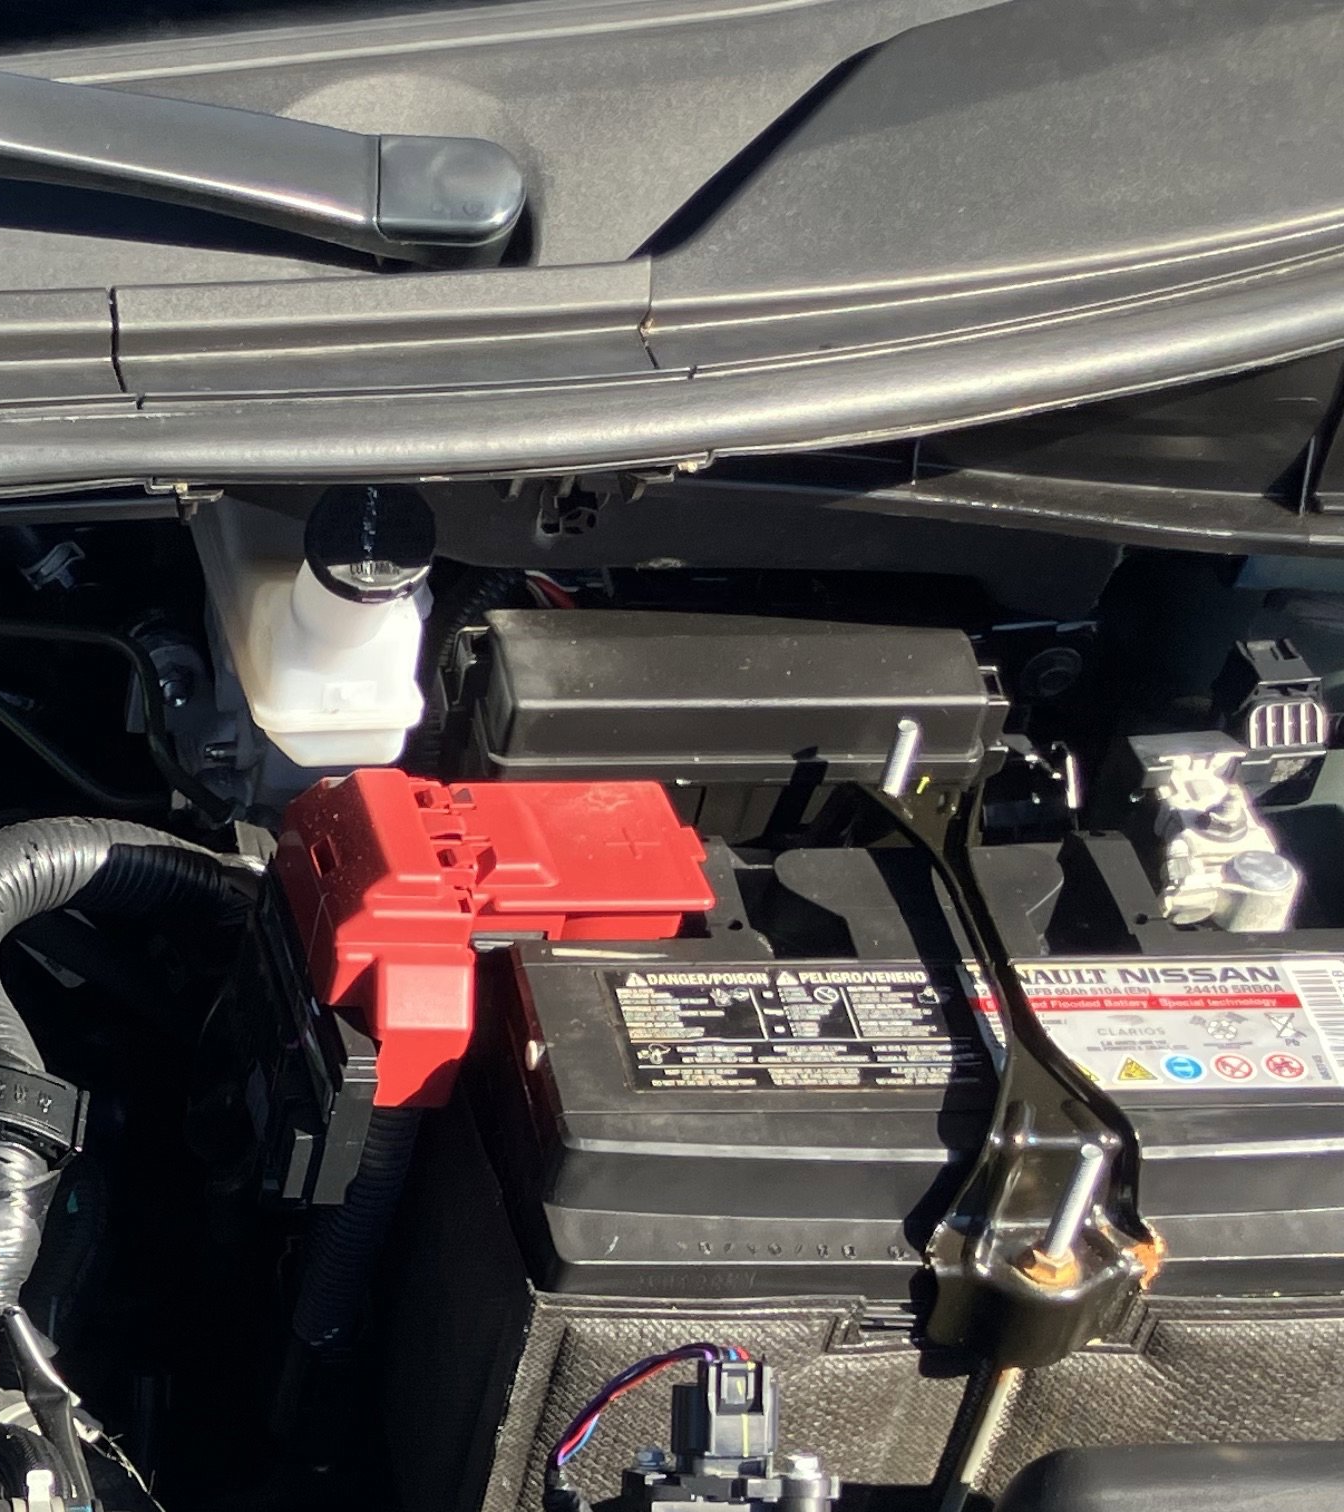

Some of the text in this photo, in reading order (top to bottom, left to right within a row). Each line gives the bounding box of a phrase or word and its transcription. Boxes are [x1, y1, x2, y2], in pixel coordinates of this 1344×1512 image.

[646, 972, 769, 985] DANGER/POISON
[798, 971, 927, 984] PELIGRO/VENENO
[1117, 967, 1280, 984] NISSAN
[1097, 1026, 1166, 1037] CLARIOS
